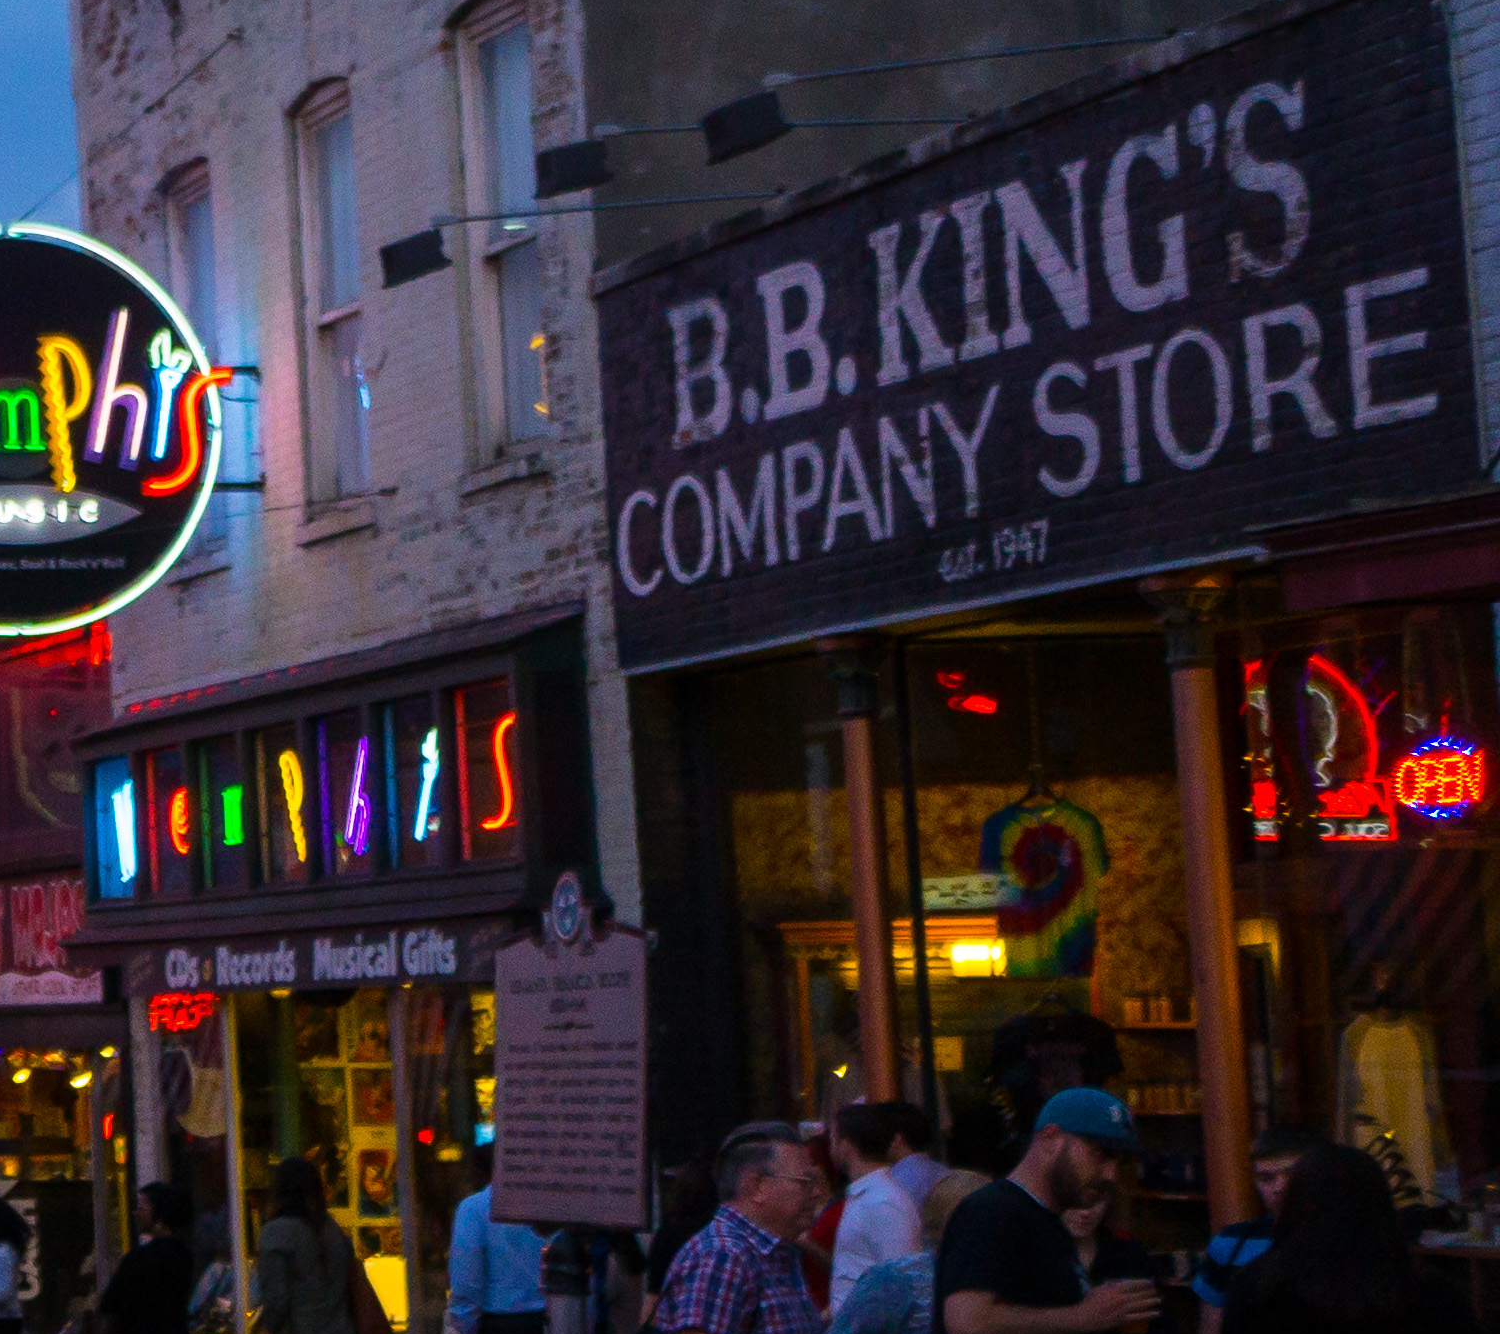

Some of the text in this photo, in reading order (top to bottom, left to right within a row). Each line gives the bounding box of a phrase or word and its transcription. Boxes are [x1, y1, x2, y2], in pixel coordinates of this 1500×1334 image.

[867, 80, 1313, 386] KING'S
[615, 269, 1439, 597] COMPANY STORE
[992, 519, 1049, 571] 1947
[1396, 748, 1485, 805] OPEN
[215, 939, 296, 987] Records
[313, 931, 398, 981] Musical
[403, 928, 458, 976] Gifts
